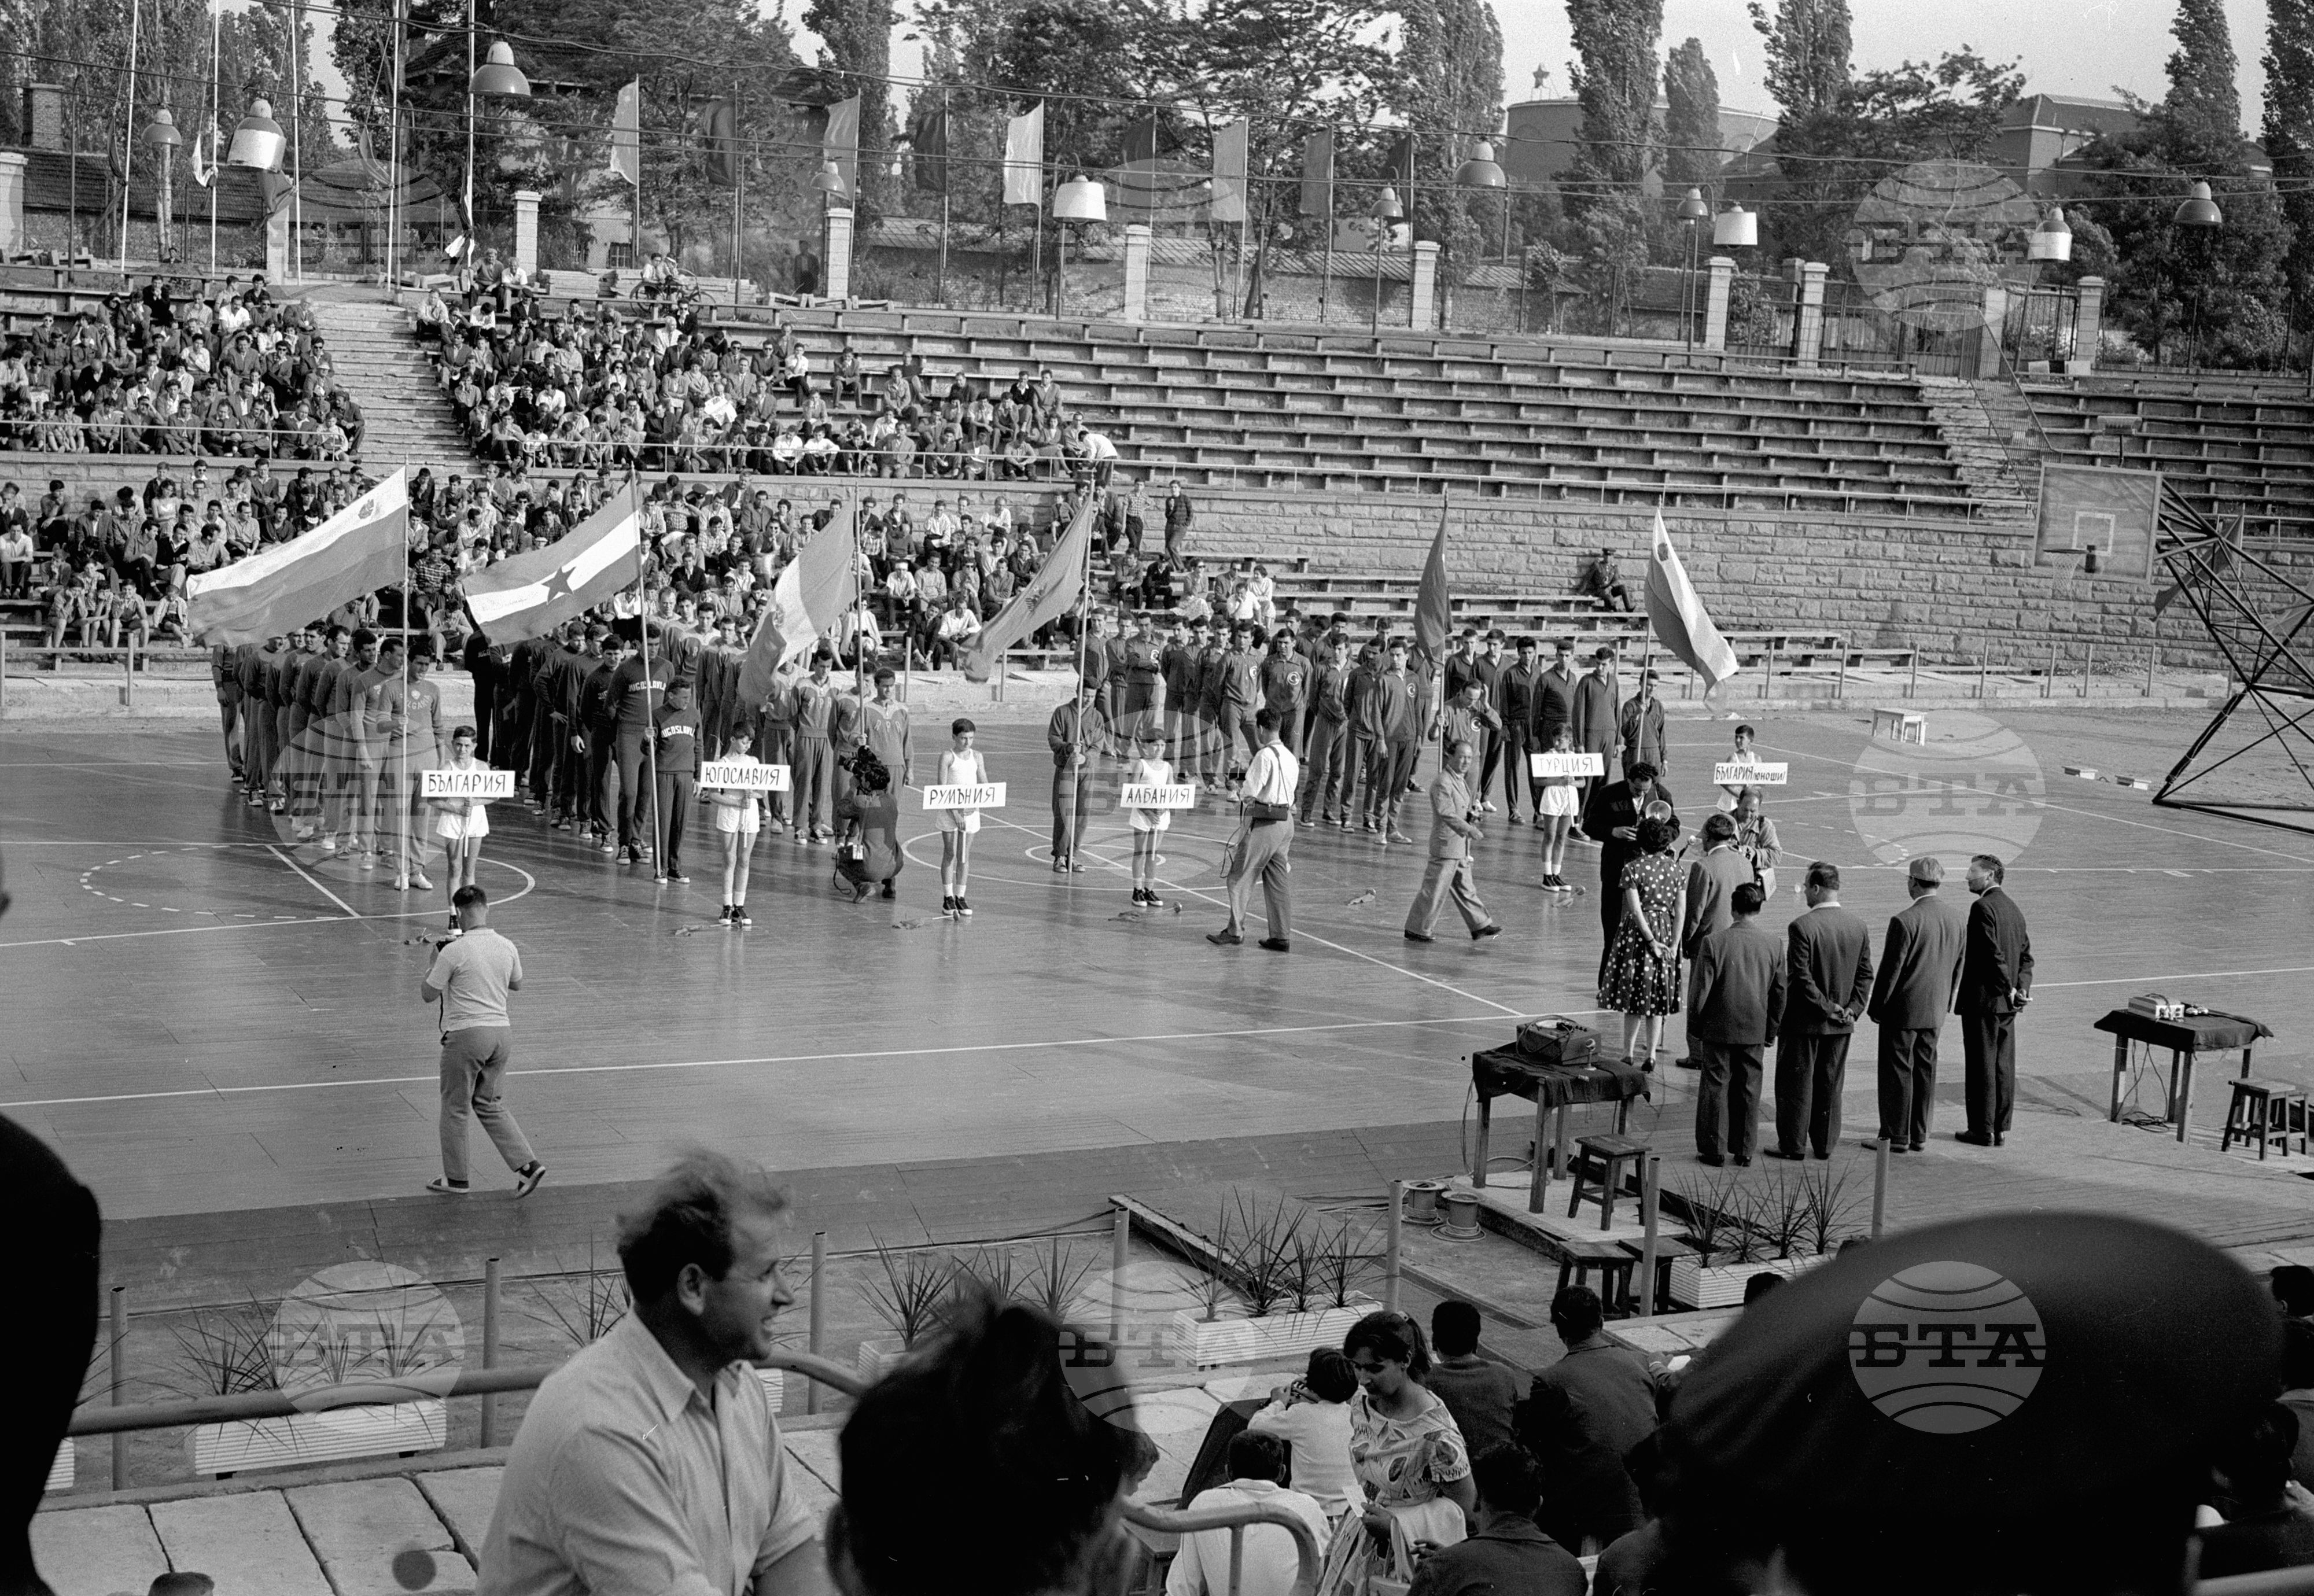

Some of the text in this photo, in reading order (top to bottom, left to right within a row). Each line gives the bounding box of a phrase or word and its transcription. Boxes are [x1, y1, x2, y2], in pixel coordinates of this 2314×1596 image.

[399, 694, 432, 709] BLGARIA
[1539, 757, 1594, 775] ТУРЦИЯ
[428, 773, 506, 793] БЪЛГАРИЯ
[705, 766, 780, 786] ЮГОСЛАВИЯ
[930, 787, 996, 805] РУМЪНИЯ
[1126, 787, 1190, 804] АЛБАНИЯ
